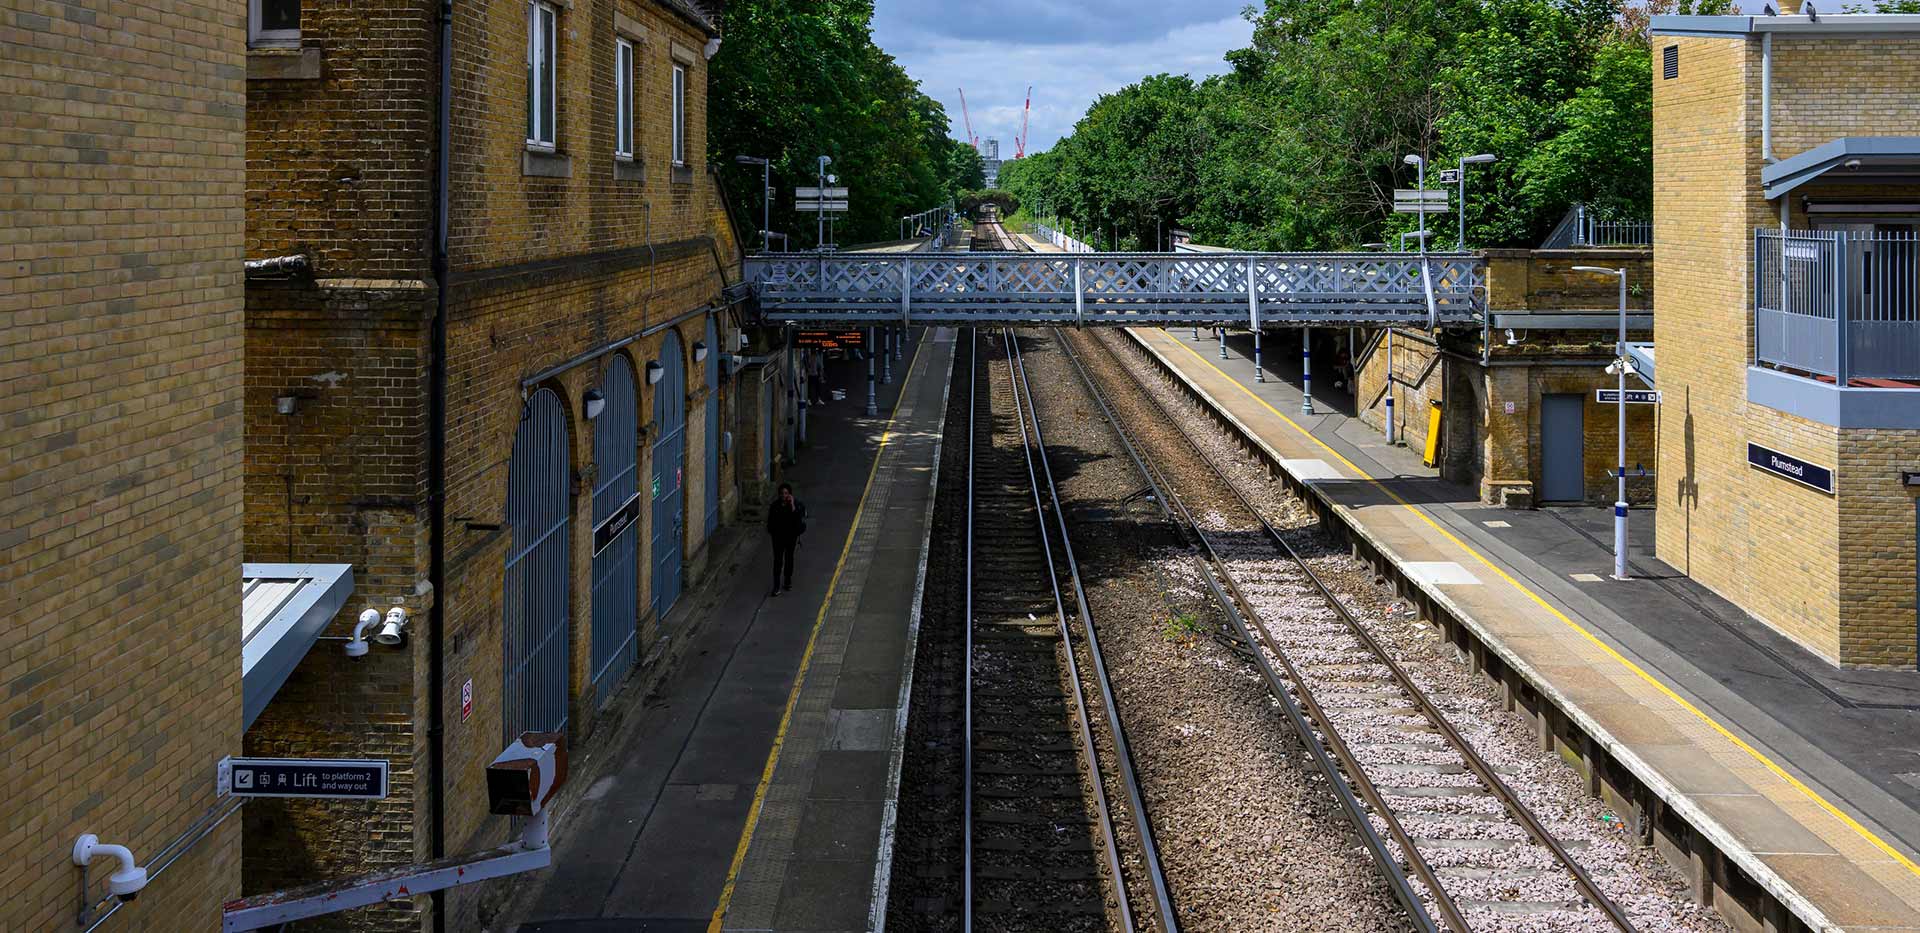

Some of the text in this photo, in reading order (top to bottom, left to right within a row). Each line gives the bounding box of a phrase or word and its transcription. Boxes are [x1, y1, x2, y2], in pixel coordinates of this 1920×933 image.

[1771, 455, 1803, 476] Plumstead
[294, 773, 318, 787] Lift
[331, 772, 365, 781] platform
[366, 772, 371, 780] 2
[321, 782, 337, 790] and
[338, 783, 353, 792] way
